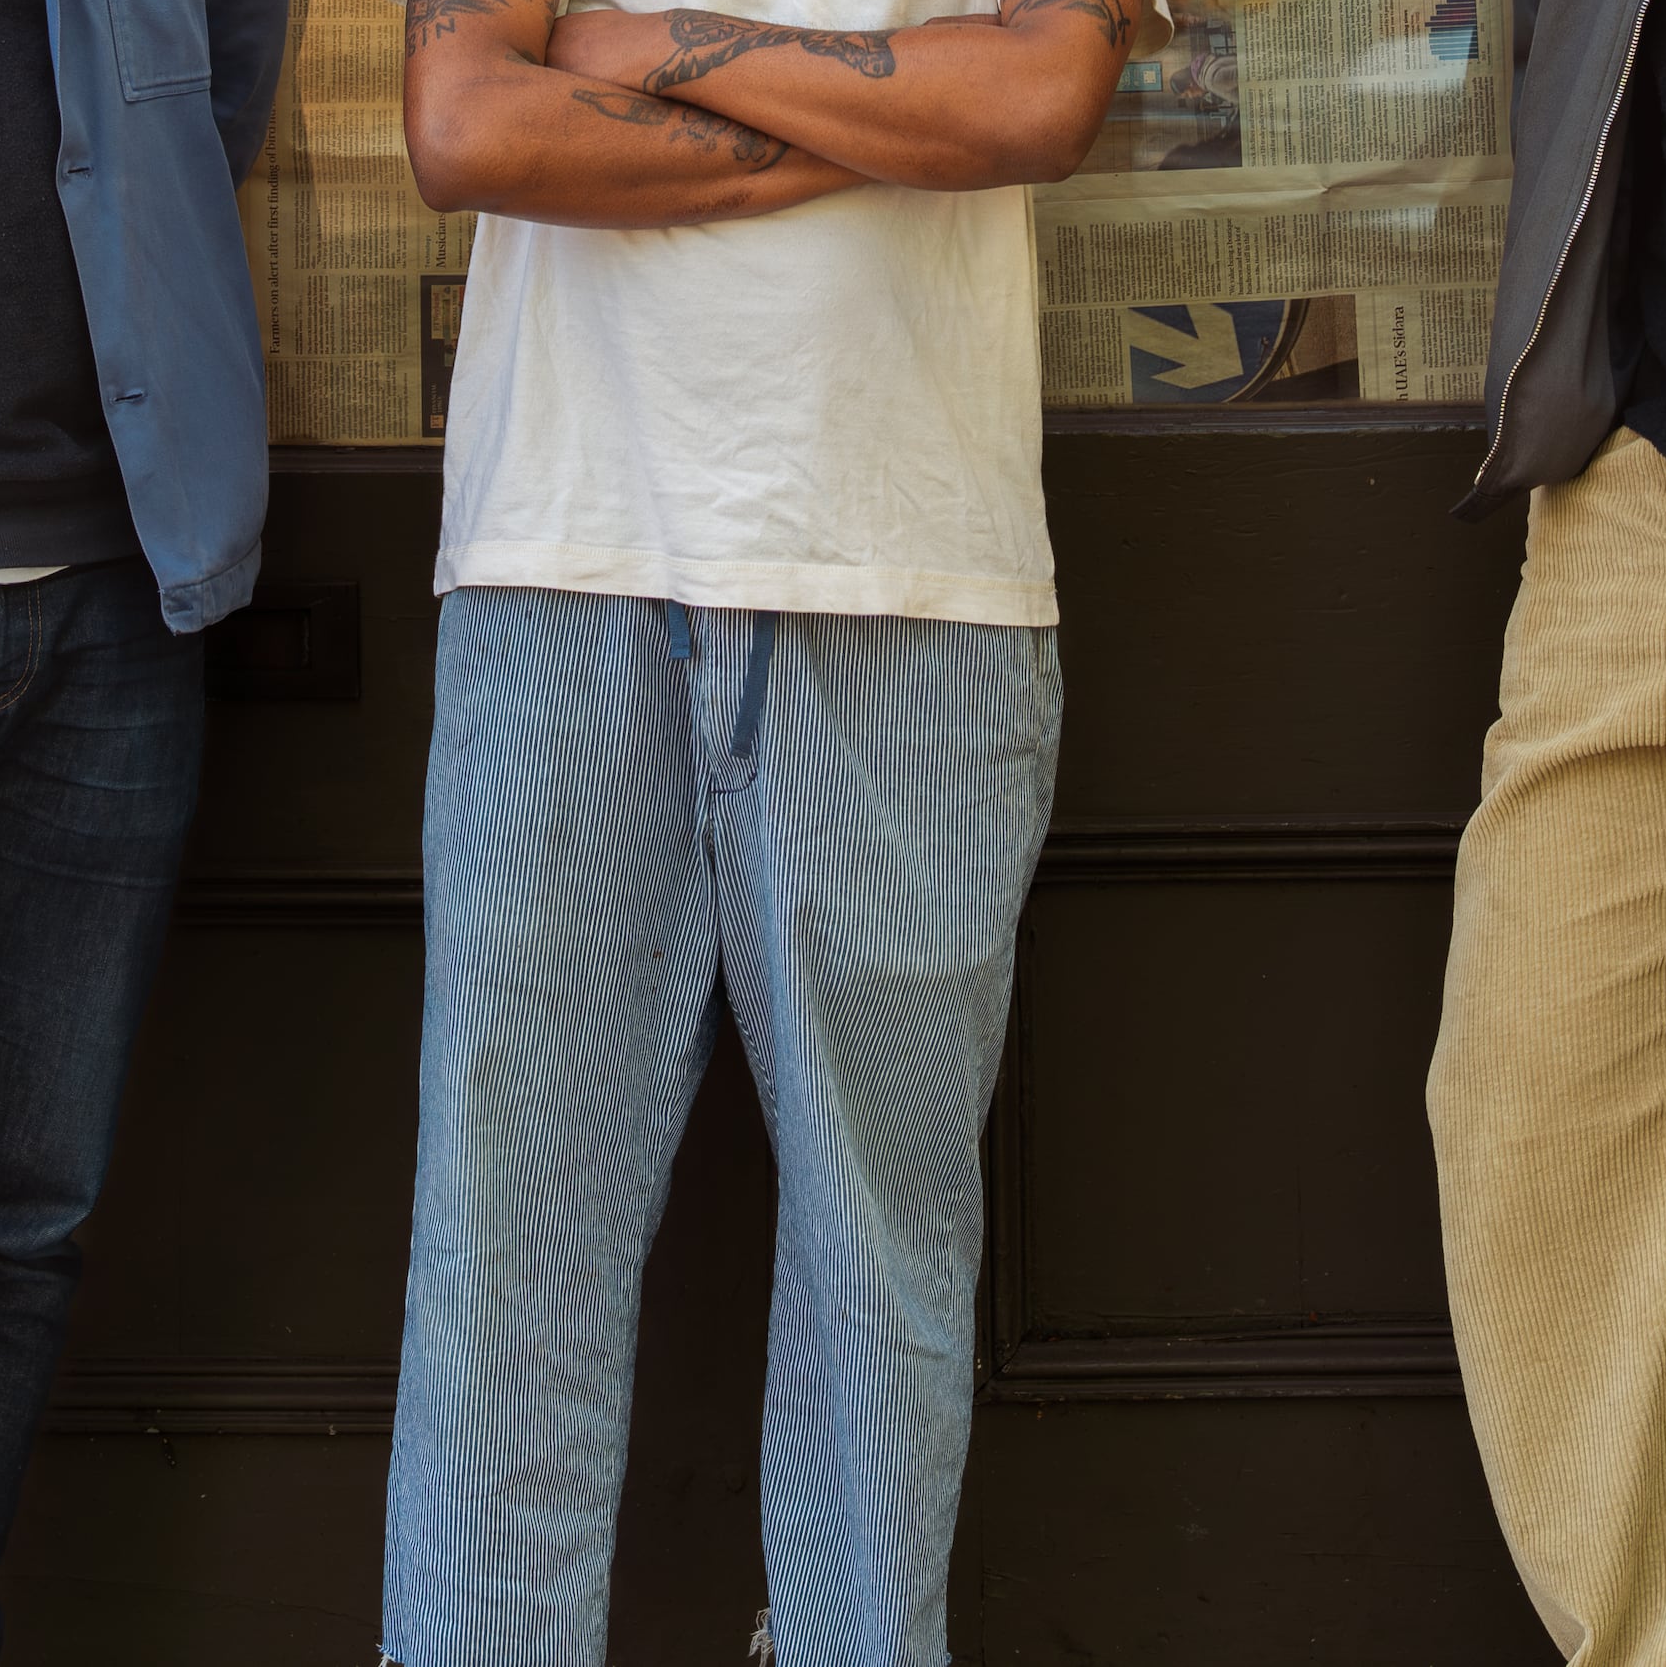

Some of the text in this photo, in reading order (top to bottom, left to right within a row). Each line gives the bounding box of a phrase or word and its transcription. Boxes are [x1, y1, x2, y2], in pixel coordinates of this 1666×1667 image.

[265, 152, 277, 163] of
[268, 164, 280, 203] finding
[267, 205, 279, 229] first
[267, 231, 279, 258] after
[435, 212, 447, 268] Musicians
[268, 261, 280, 288] alert
[270, 290, 280, 305] on
[269, 306, 280, 354] Farmers
[1392, 306, 1406, 348] Sidara
[1394, 350, 1408, 390] UAE's
